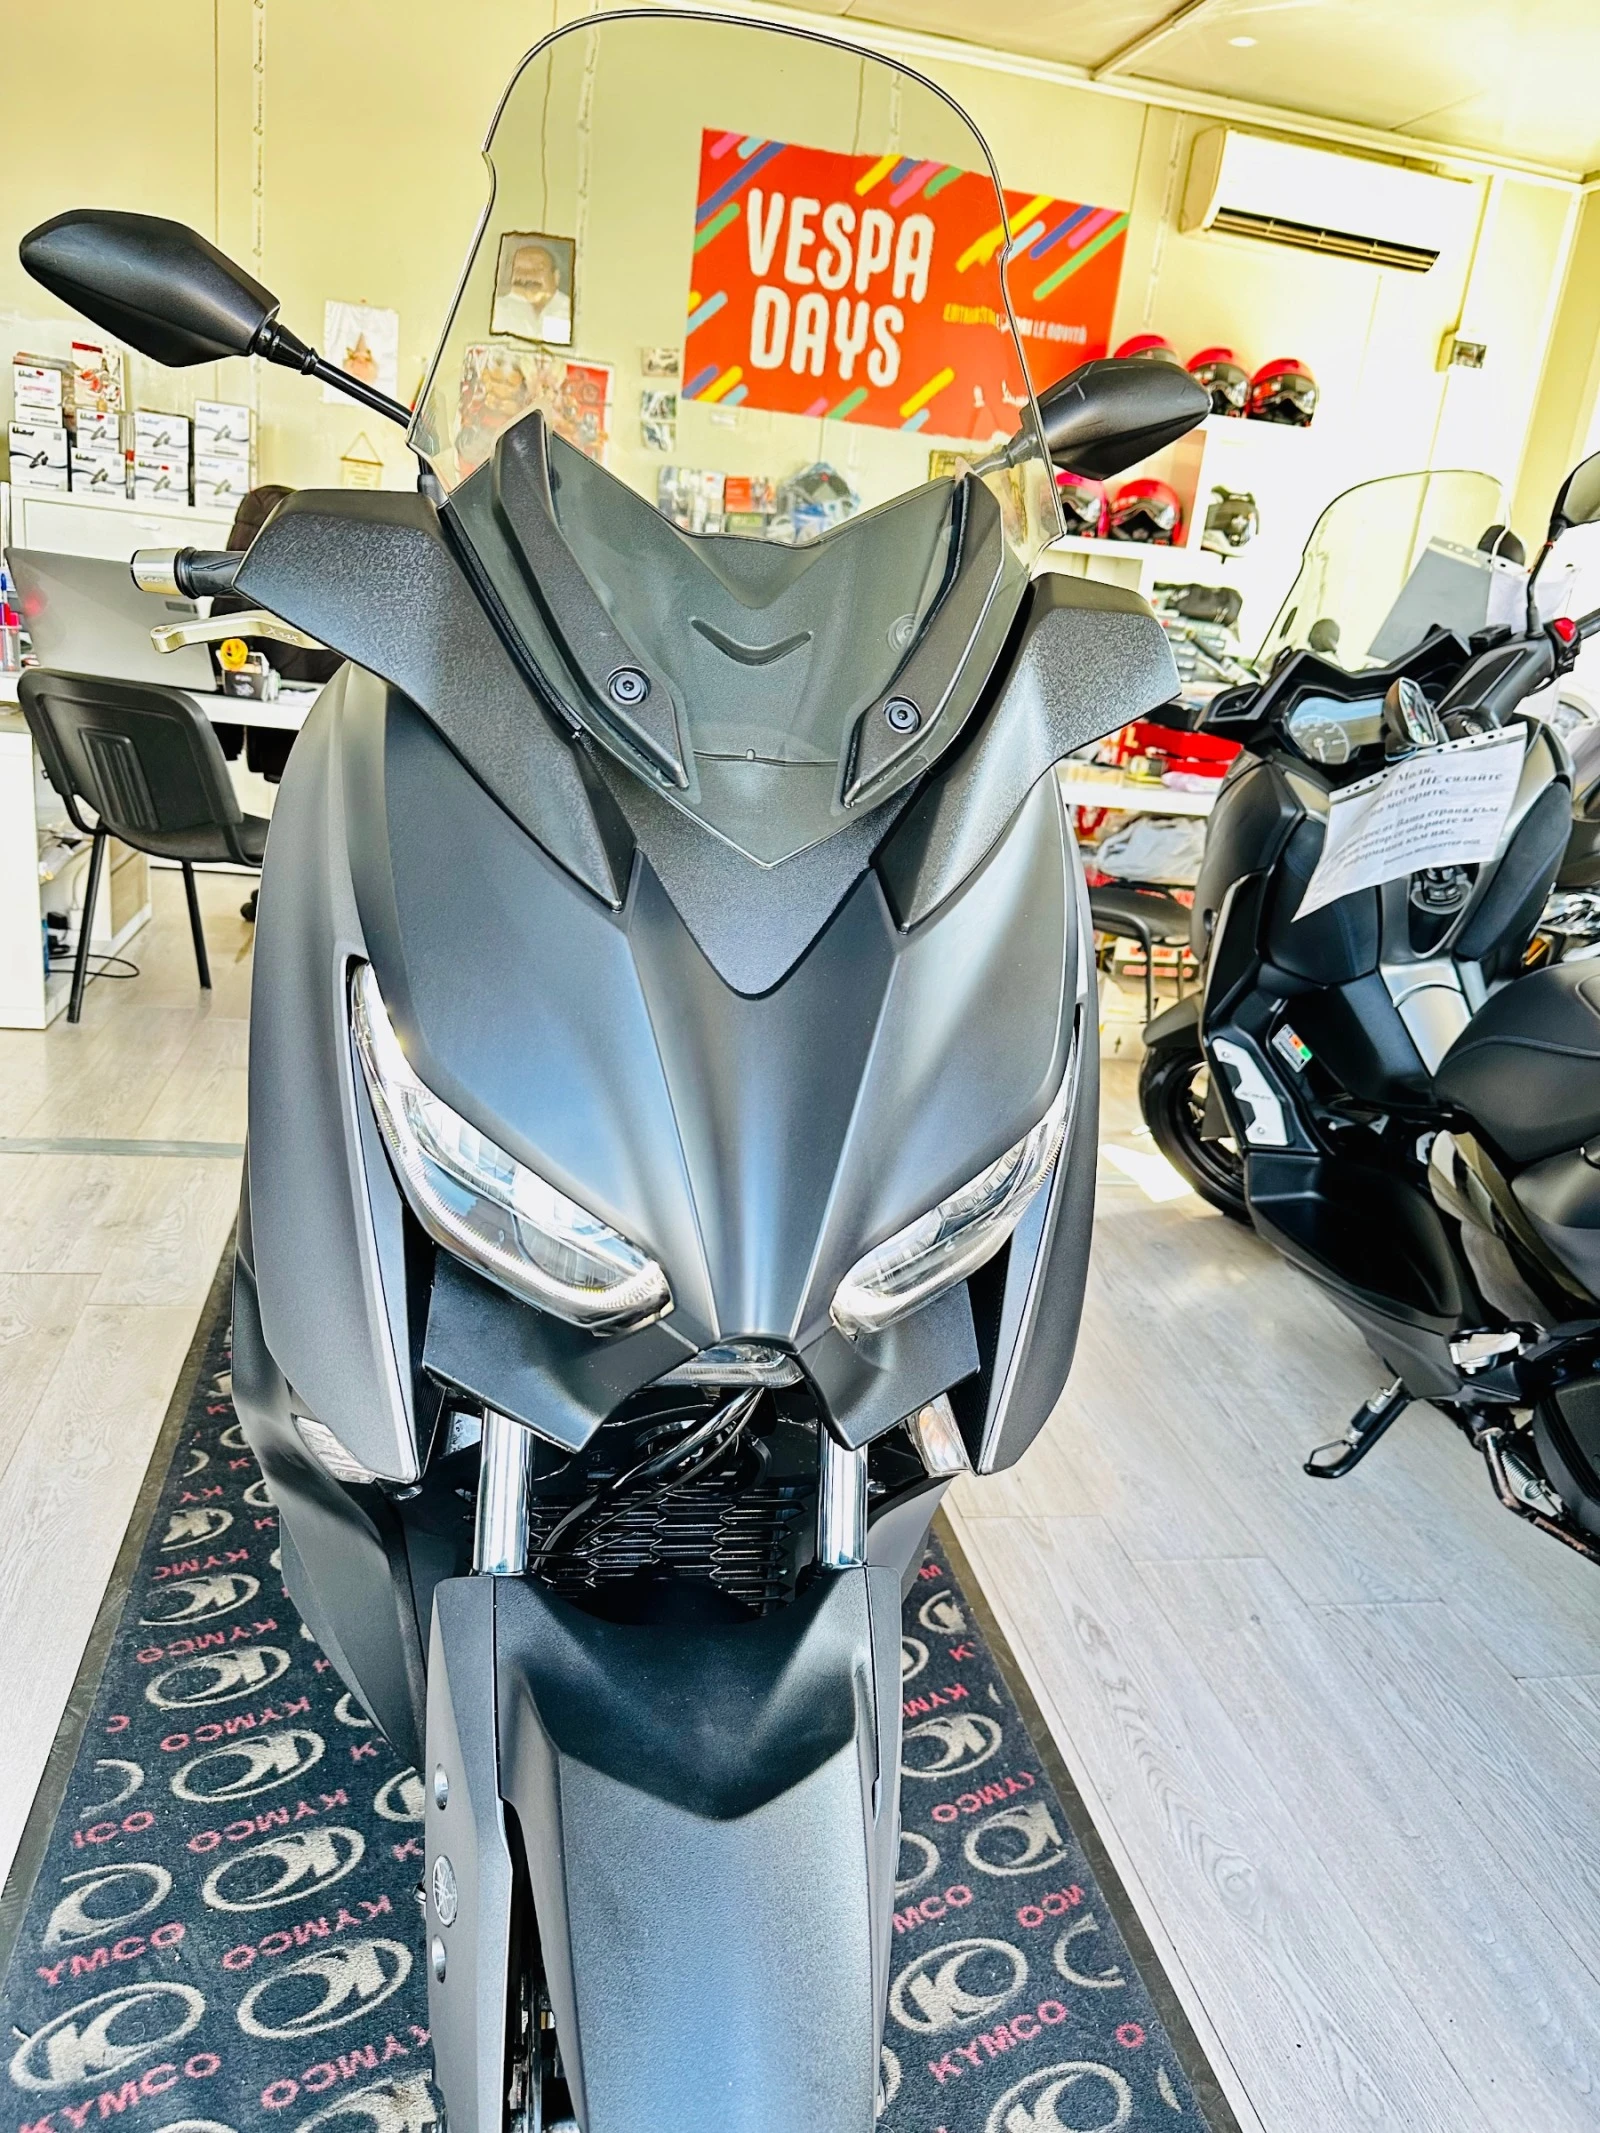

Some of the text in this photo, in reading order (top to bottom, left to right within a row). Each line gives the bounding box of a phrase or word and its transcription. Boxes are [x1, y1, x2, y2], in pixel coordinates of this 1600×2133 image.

[747, 187, 936, 304] VESPA
[750, 285, 905, 388] DAYS
[136, 1618, 279, 1664] KYMCO
[160, 1696, 311, 1752] KYMCO
[187, 1789, 350, 1853] KYMCO
[222, 1895, 393, 1970] KYMCO
[928, 2000, 1068, 2084] KYMCO
